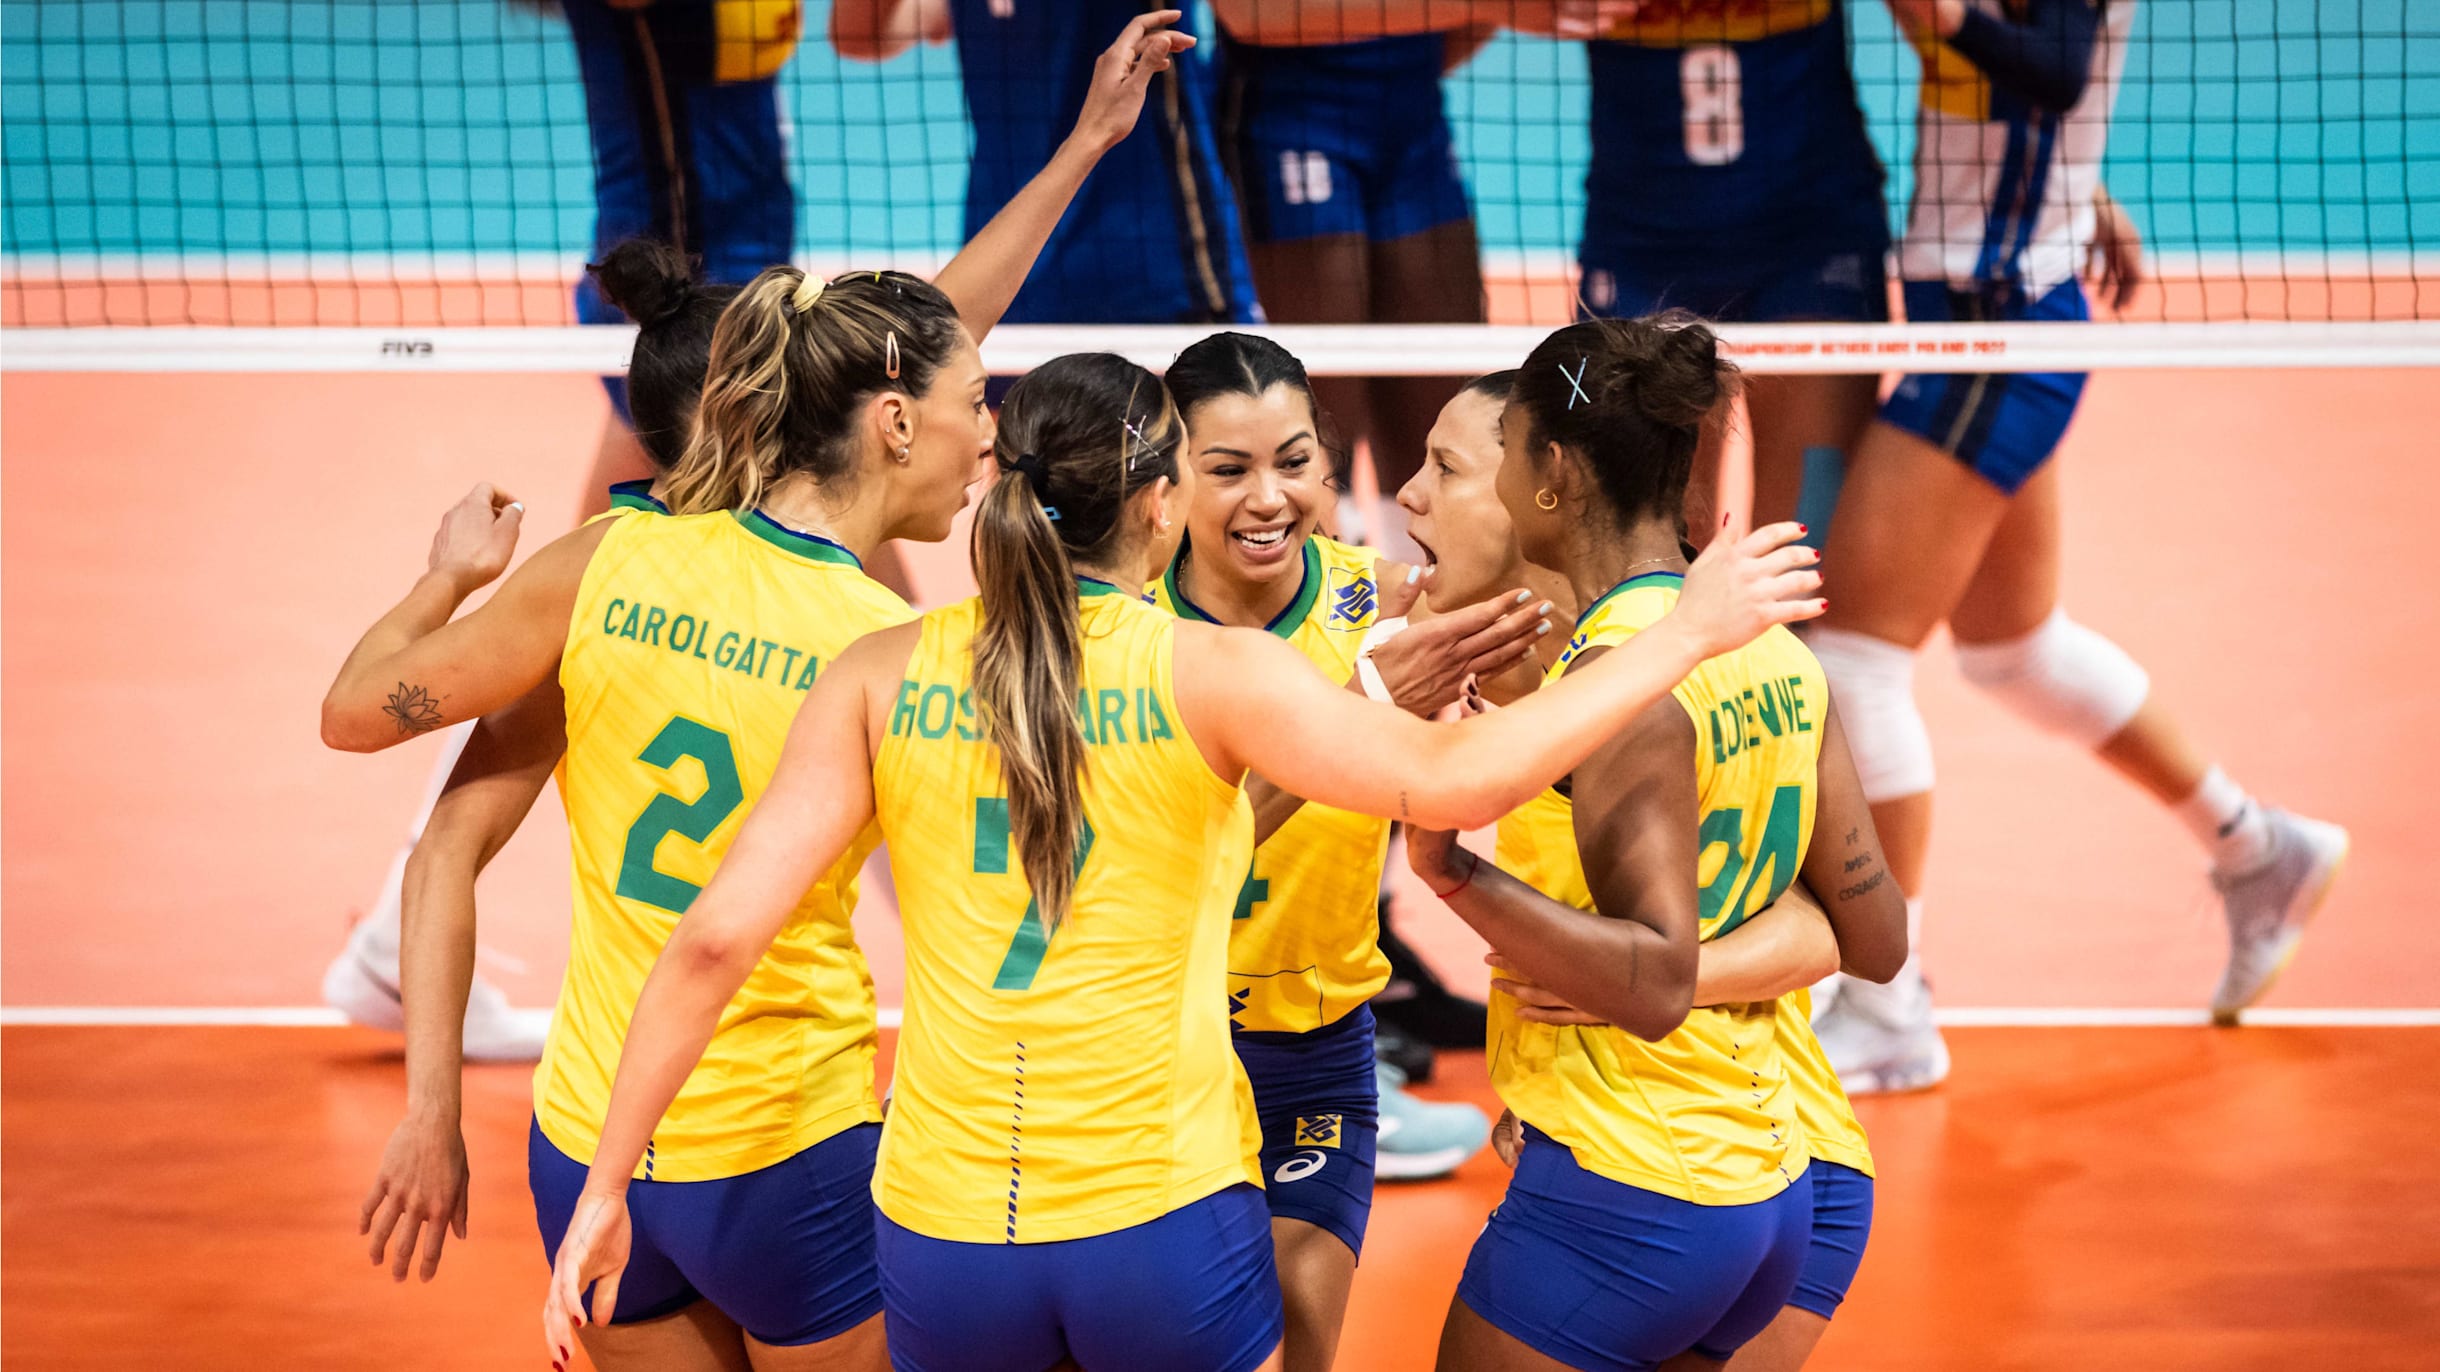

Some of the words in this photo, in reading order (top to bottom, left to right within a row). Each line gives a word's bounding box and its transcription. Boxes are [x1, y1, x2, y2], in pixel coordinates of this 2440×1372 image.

[1680, 46, 1744, 166] 8
[892, 680, 1174, 745] ROSARIA
[615, 716, 744, 914] 2
[973, 797, 1096, 990] 7
